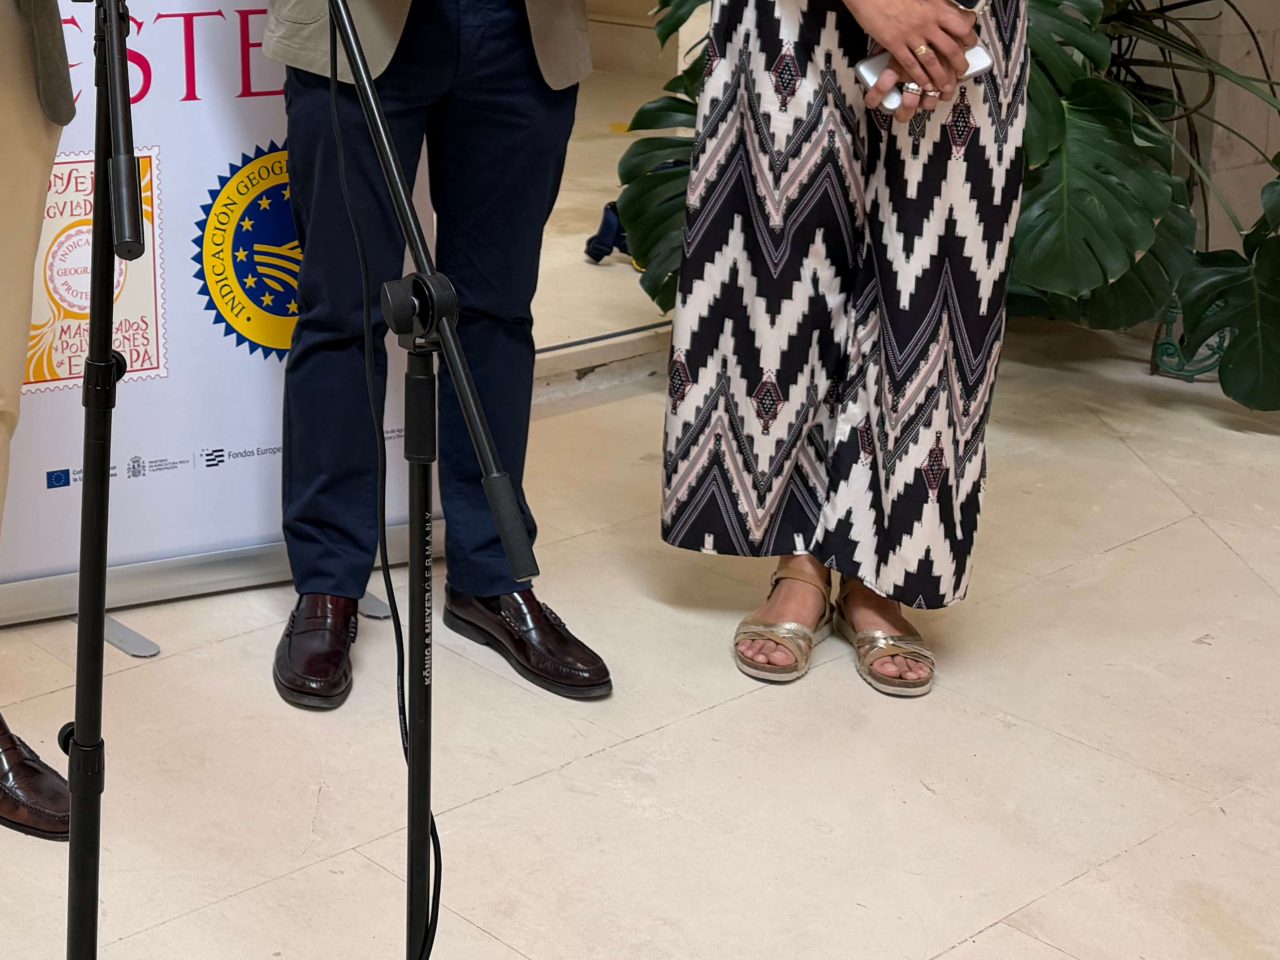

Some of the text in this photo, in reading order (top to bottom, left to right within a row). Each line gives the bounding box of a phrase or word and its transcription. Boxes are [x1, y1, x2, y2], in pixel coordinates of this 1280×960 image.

[210, 158, 290, 319] INDICACIÓN GEOG
[227, 448, 255, 460] Fondos
